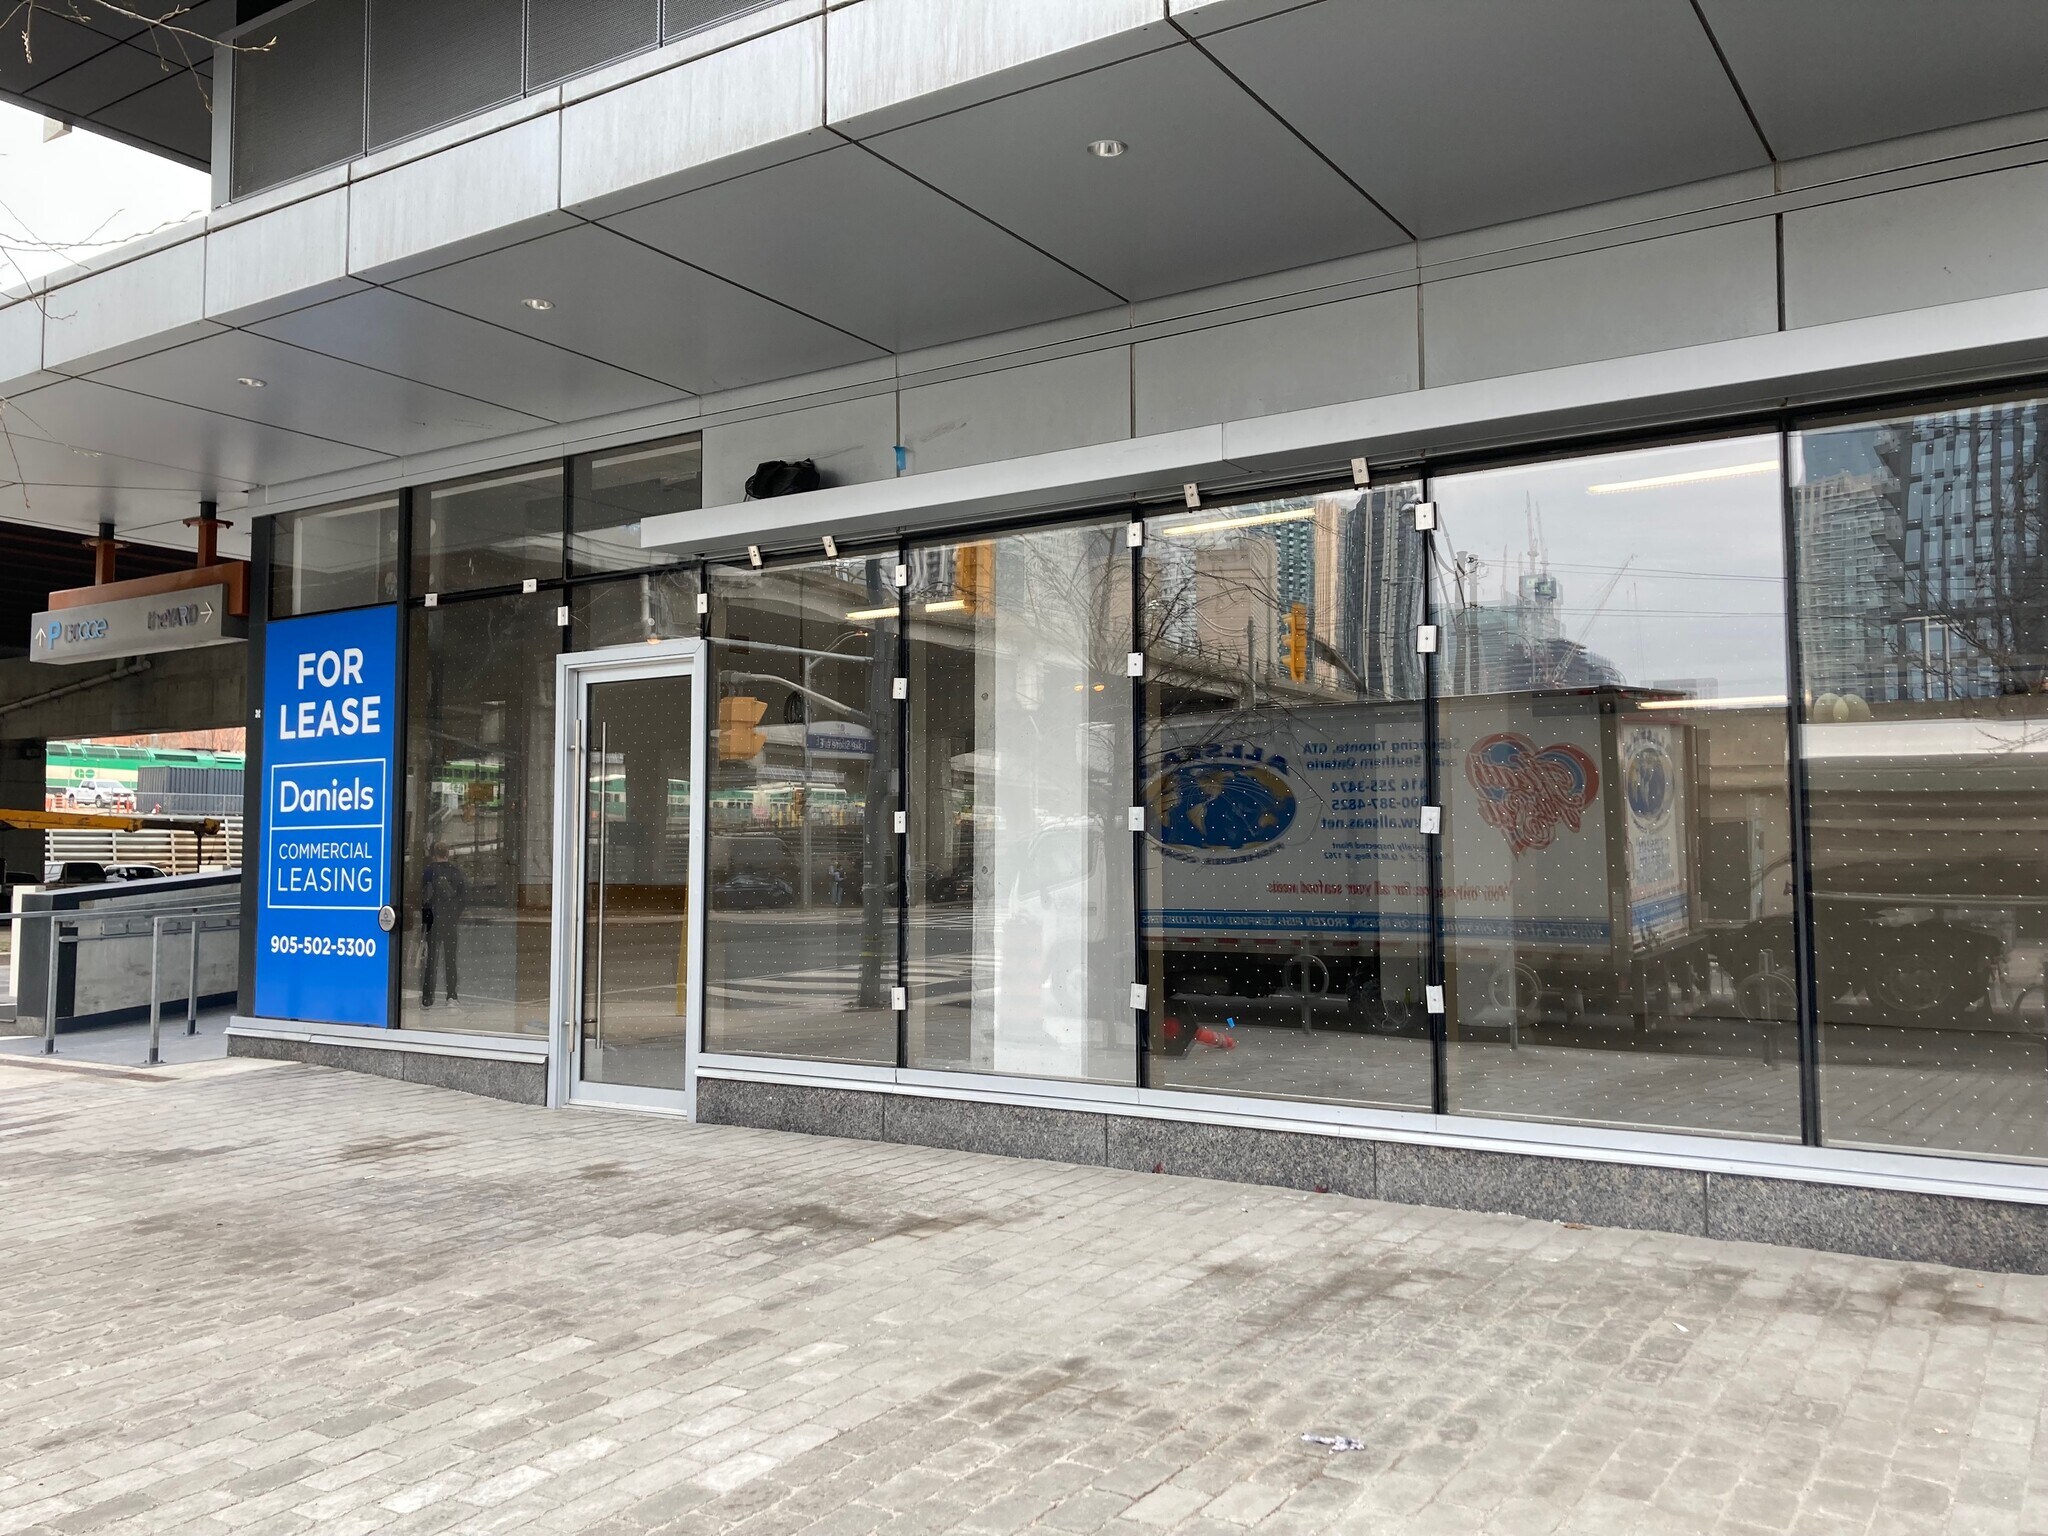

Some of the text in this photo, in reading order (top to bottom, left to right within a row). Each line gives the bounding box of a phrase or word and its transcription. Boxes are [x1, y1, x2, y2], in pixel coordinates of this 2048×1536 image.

[48, 621, 62, 649] P
[298, 648, 363, 689] FOR
[280, 696, 380, 739] LEASE
[280, 777, 374, 812] Daniels
[279, 842, 372, 859] COMMERCIAL
[277, 866, 372, 893] LEASING
[271, 935, 376, 957] 905-502-5300
